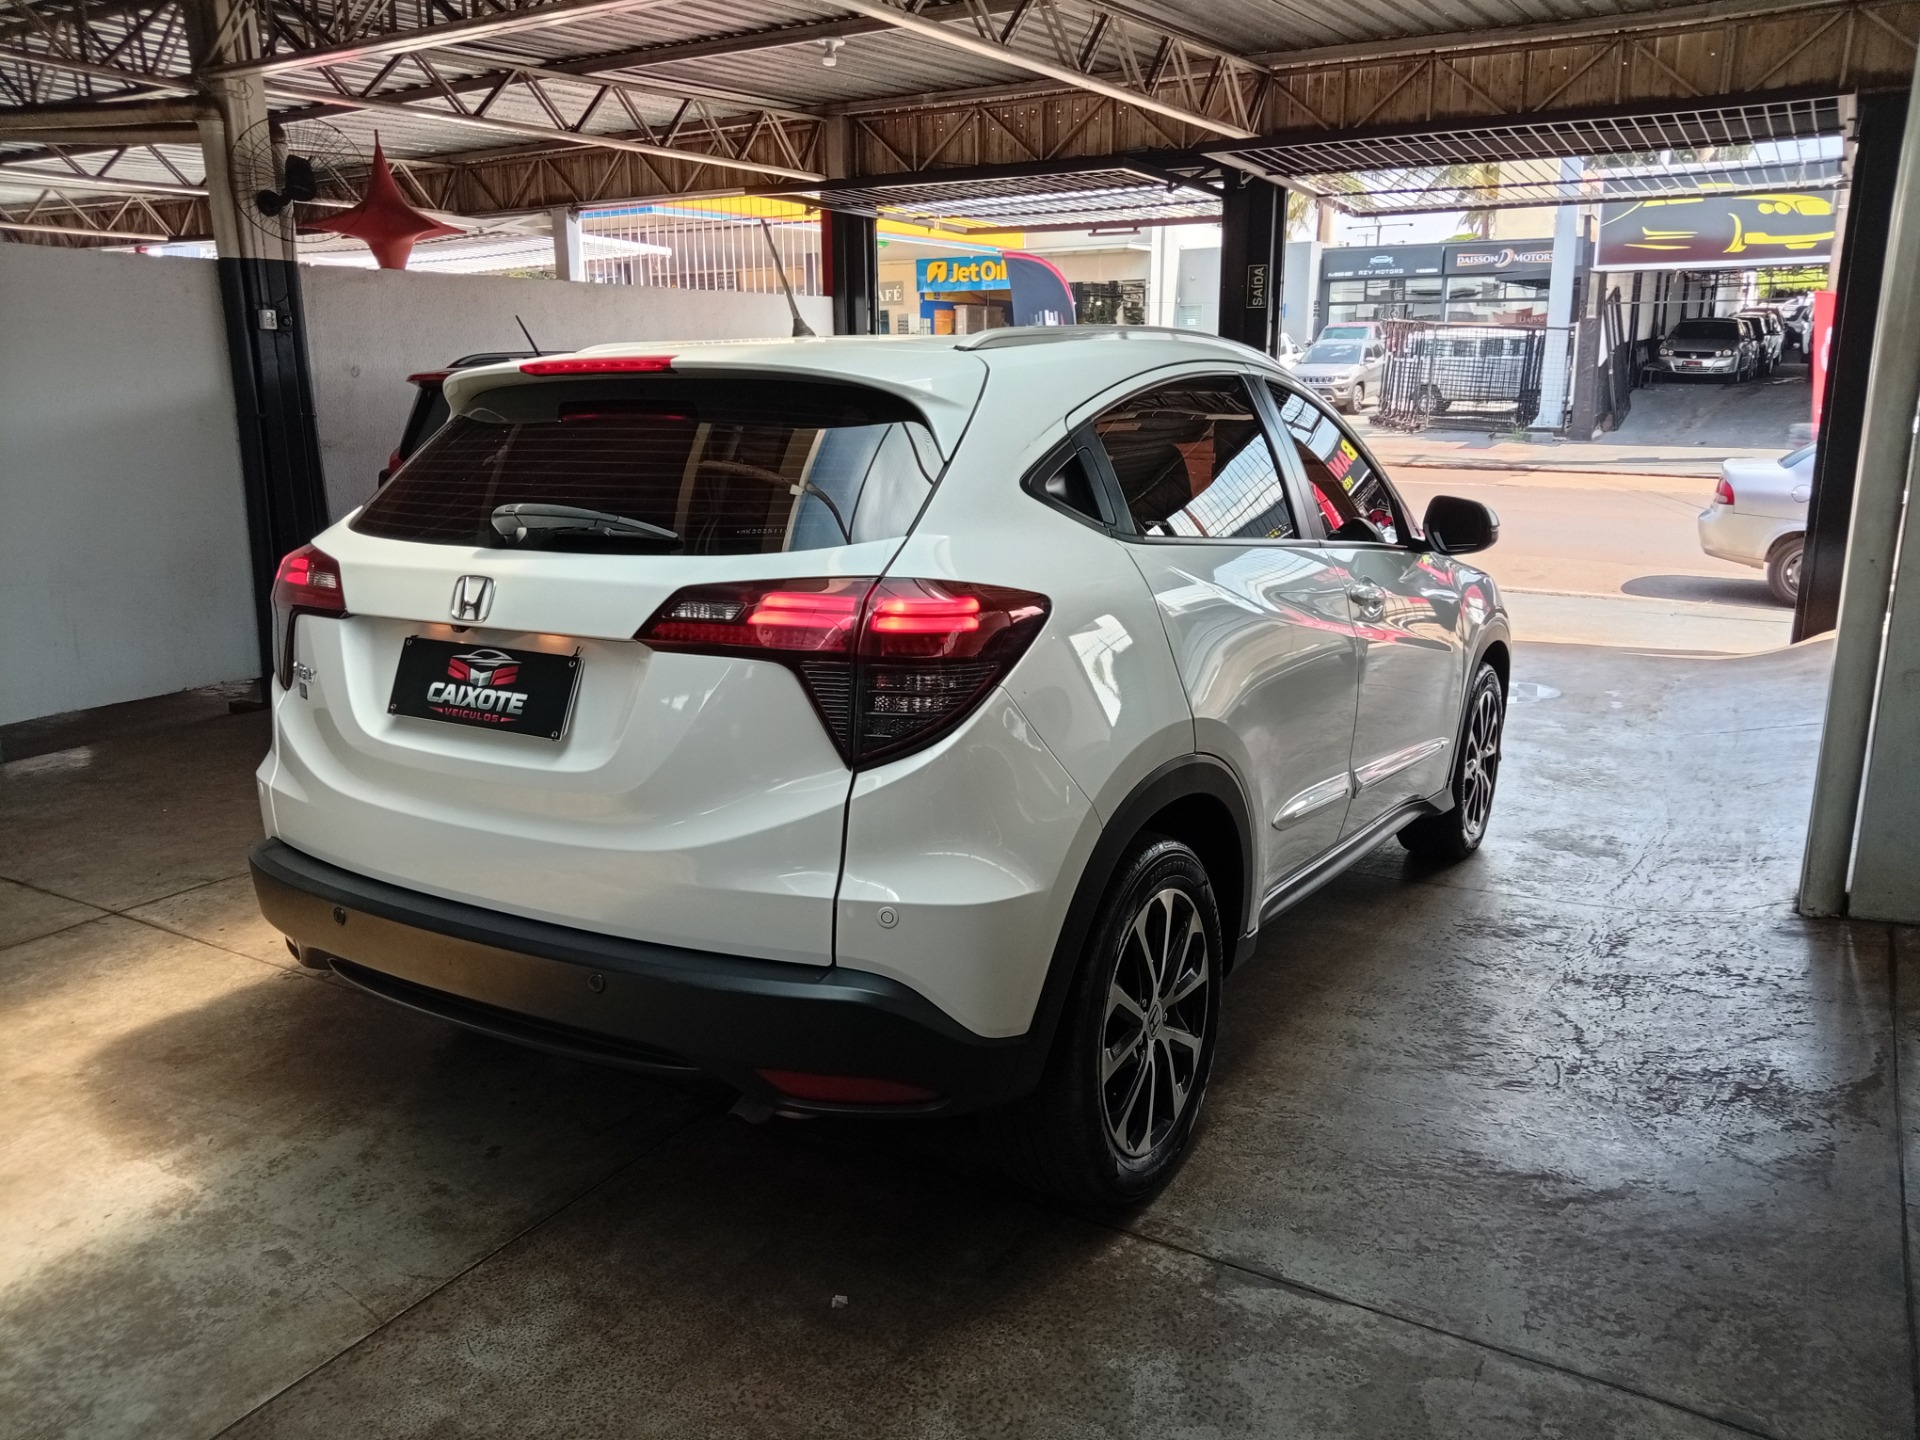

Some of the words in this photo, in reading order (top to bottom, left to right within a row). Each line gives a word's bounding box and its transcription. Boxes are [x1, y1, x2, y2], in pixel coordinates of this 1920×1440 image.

[1457, 255, 1498, 265] DAISSON
[1513, 252, 1554, 263] MOTORS
[1250, 266, 1265, 306] SAÍDA
[427, 681, 529, 715] CAIXOTE
[445, 707, 500, 723] VEICULOS
